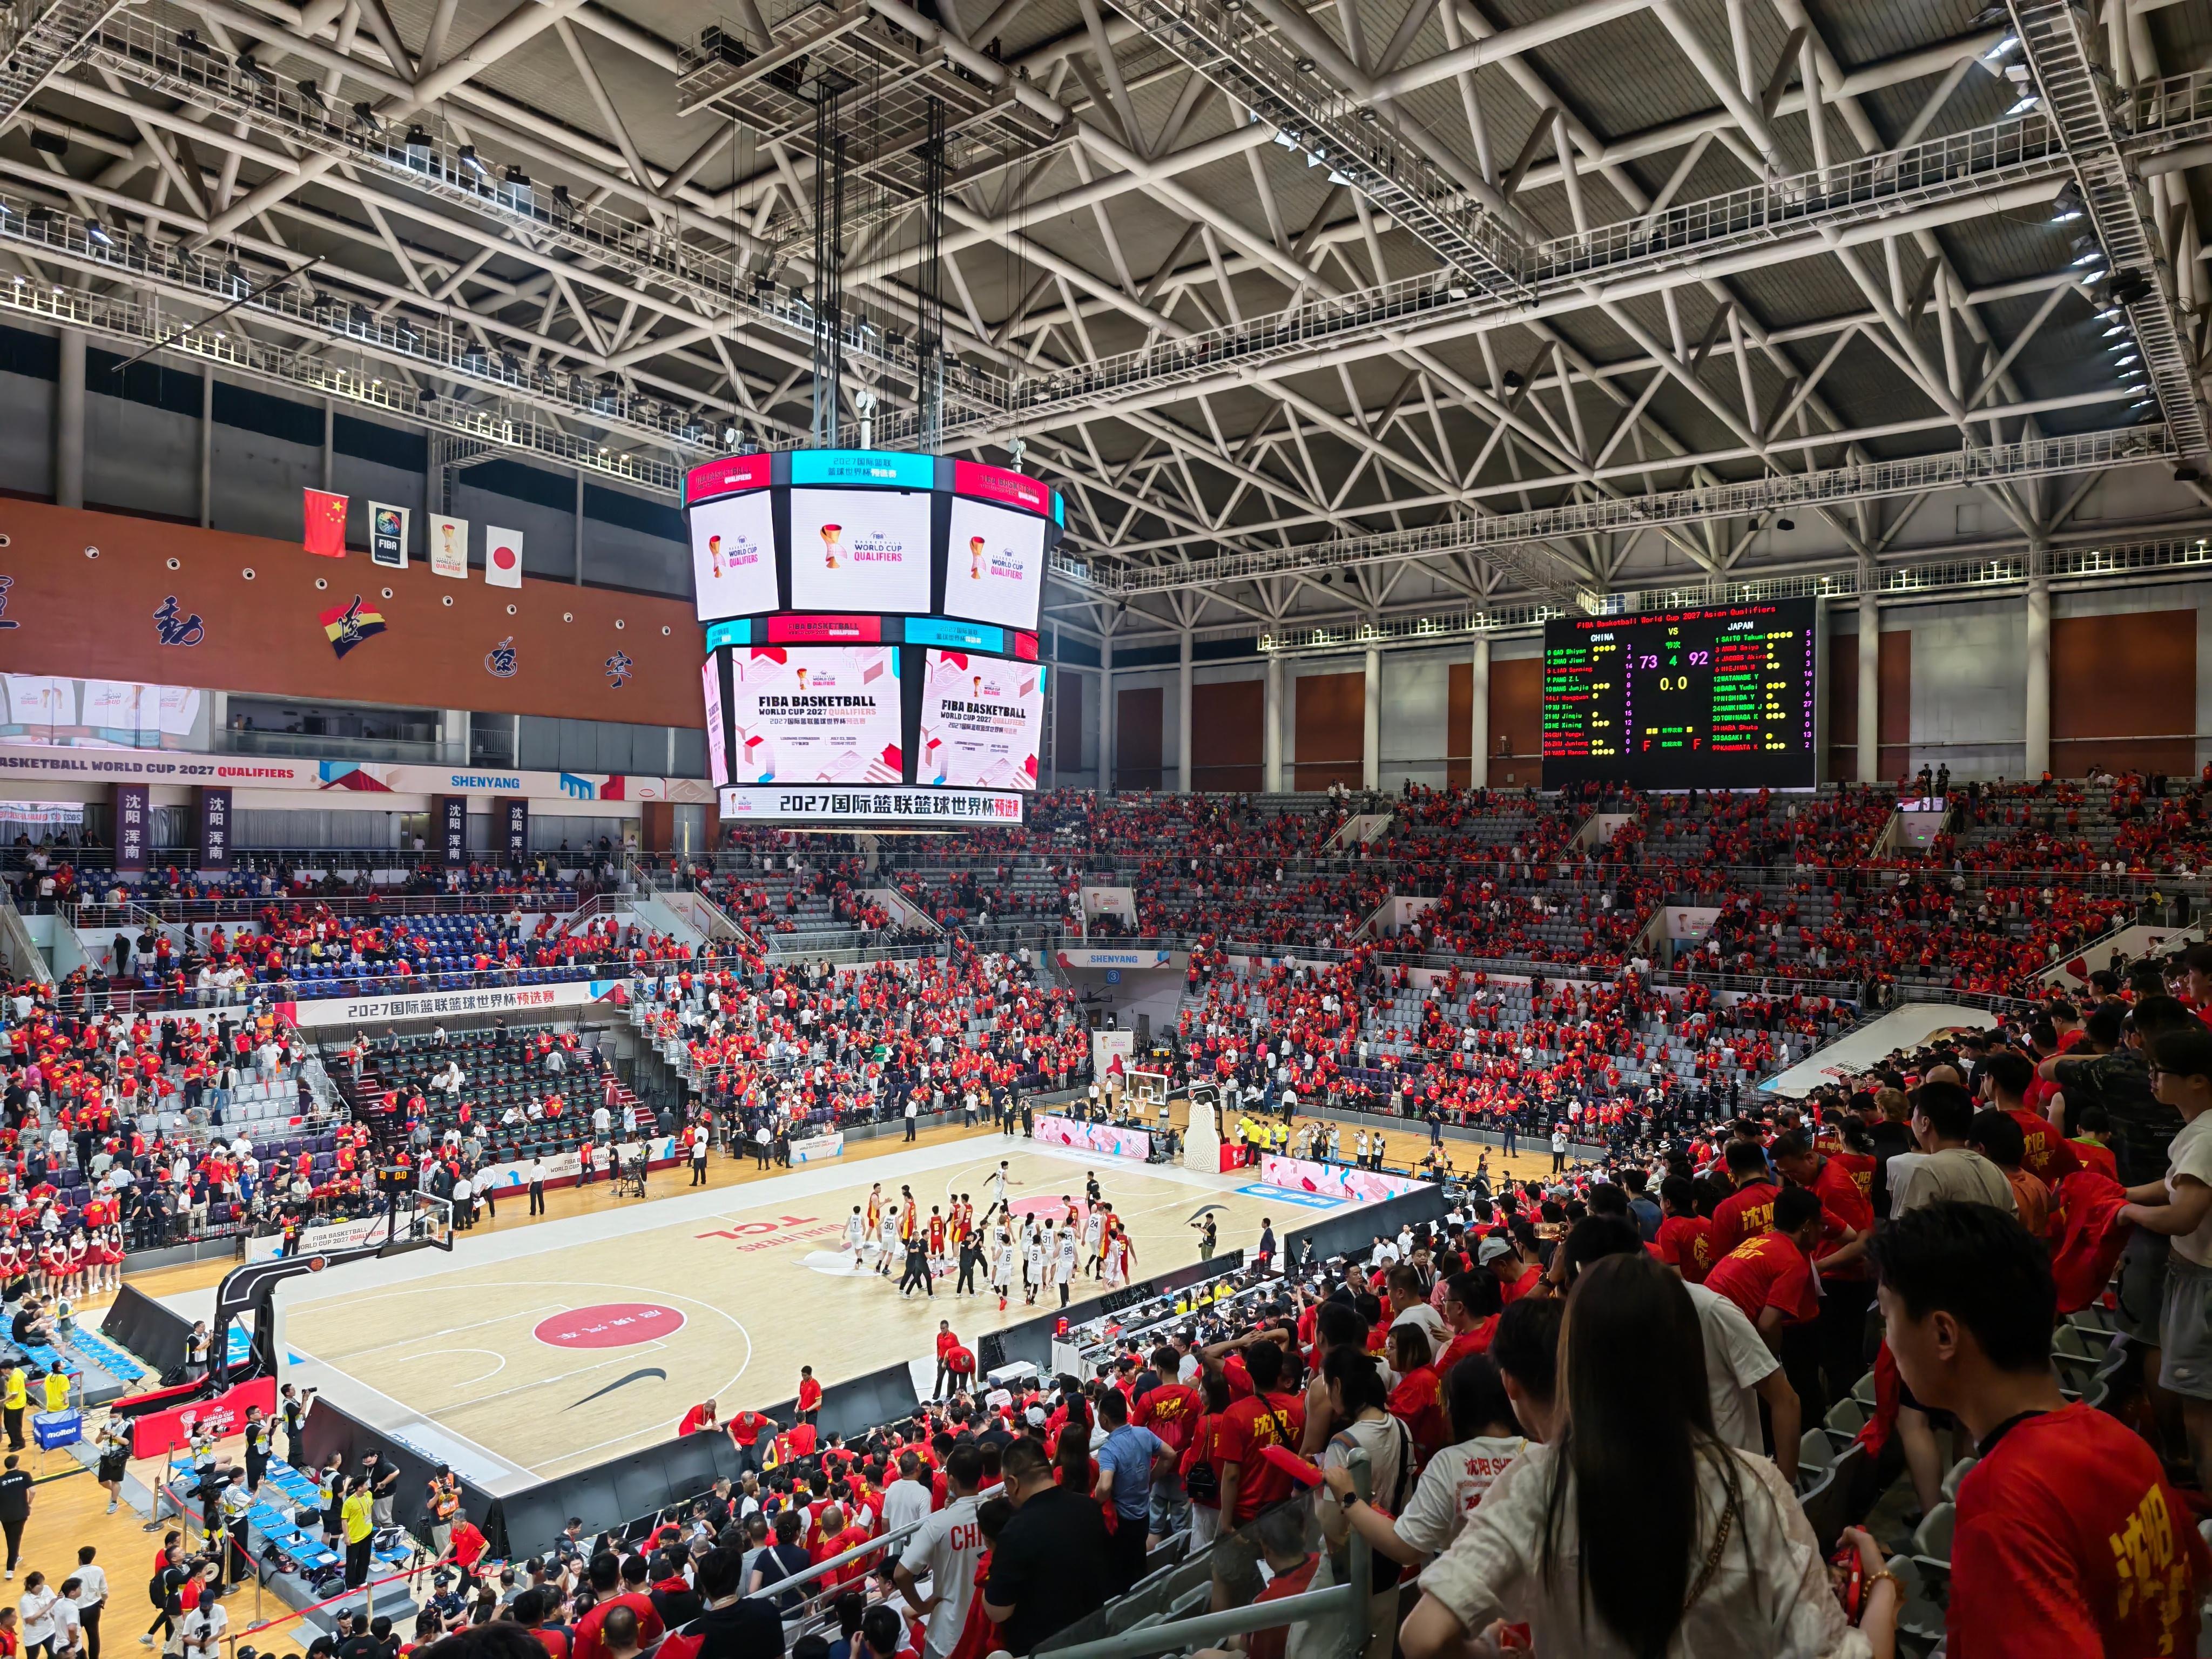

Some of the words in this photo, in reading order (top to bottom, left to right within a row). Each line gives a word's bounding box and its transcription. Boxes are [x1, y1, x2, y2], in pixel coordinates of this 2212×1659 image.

[379, 539, 397, 550] FIBA
[729, 549, 746, 557] WORLD
[854, 552, 902, 562] QUALIFIERS
[730, 554, 758, 568] QUALIFIERS
[992, 558, 1011, 568] WORLD
[991, 565, 1023, 580] QUALIFIERS
[1597, 618, 1637, 628] Basketball
[1641, 615, 1662, 624] World
[1730, 606, 1776, 616] Qualifiers
[1668, 627, 1678, 635] VS
[1728, 621, 1754, 631] JAPAN
[1590, 632, 1614, 642] CHINA
[1640, 655, 1657, 669] 73
[1669, 655, 1677, 666] 4
[1689, 651, 1708, 665] 92
[759, 696, 789, 707] FIBA
[791, 696, 876, 707] BASKETBALL
[942, 699, 964, 712] FIBA
[967, 702, 1026, 719] BASKETBALL
[941, 712, 961, 720] WORLD
[1643, 740, 1651, 751] F
[1694, 739, 1702, 750] F
[92, 761, 143, 772] WORLD
[146, 764, 176, 773] CUP
[179, 765, 215, 775] 2027
[218, 766, 294, 778] QUALIFIERS
[451, 775, 520, 788] SHENYANG
[126, 795, 141, 824] 沈阳
[210, 798, 224, 825] 沈阳
[780, 794, 1019, 818] 2027国际篮联篮球世界杯预选赛
[449, 805, 461, 830] 沈阳
[512, 807, 523, 832] 沈阳
[124, 830, 140, 859] 浑南
[208, 832, 224, 859] 浑南
[449, 834, 461, 859] 浑南
[1091, 955, 1138, 963] SHENYANG
[348, 990, 555, 1017] 2027国际篮联篮球世界杯预选赛
[395, 1171, 407, 1180] 0.0
[694, 1216, 820, 1239] TCL
[853, 1221, 857, 1229] 1
[885, 1222, 894, 1230] 30
[1090, 1220, 1098, 1229] 24
[329, 1228, 367, 1239] BASKETBALL
[1006, 1253, 1010, 1262] 6
[1064, 1246, 1073, 1256] 99
[1156, 1398, 1181, 1416] 沈阳
[1253, 1410, 1287, 1437] 沈阳
[47, 1426, 77, 1438] molten
[1464, 1457, 1492, 1476] 沈阳
[950, 1523, 982, 1551] CHI
[2109, 1483, 2174, 1578] 沈阳
